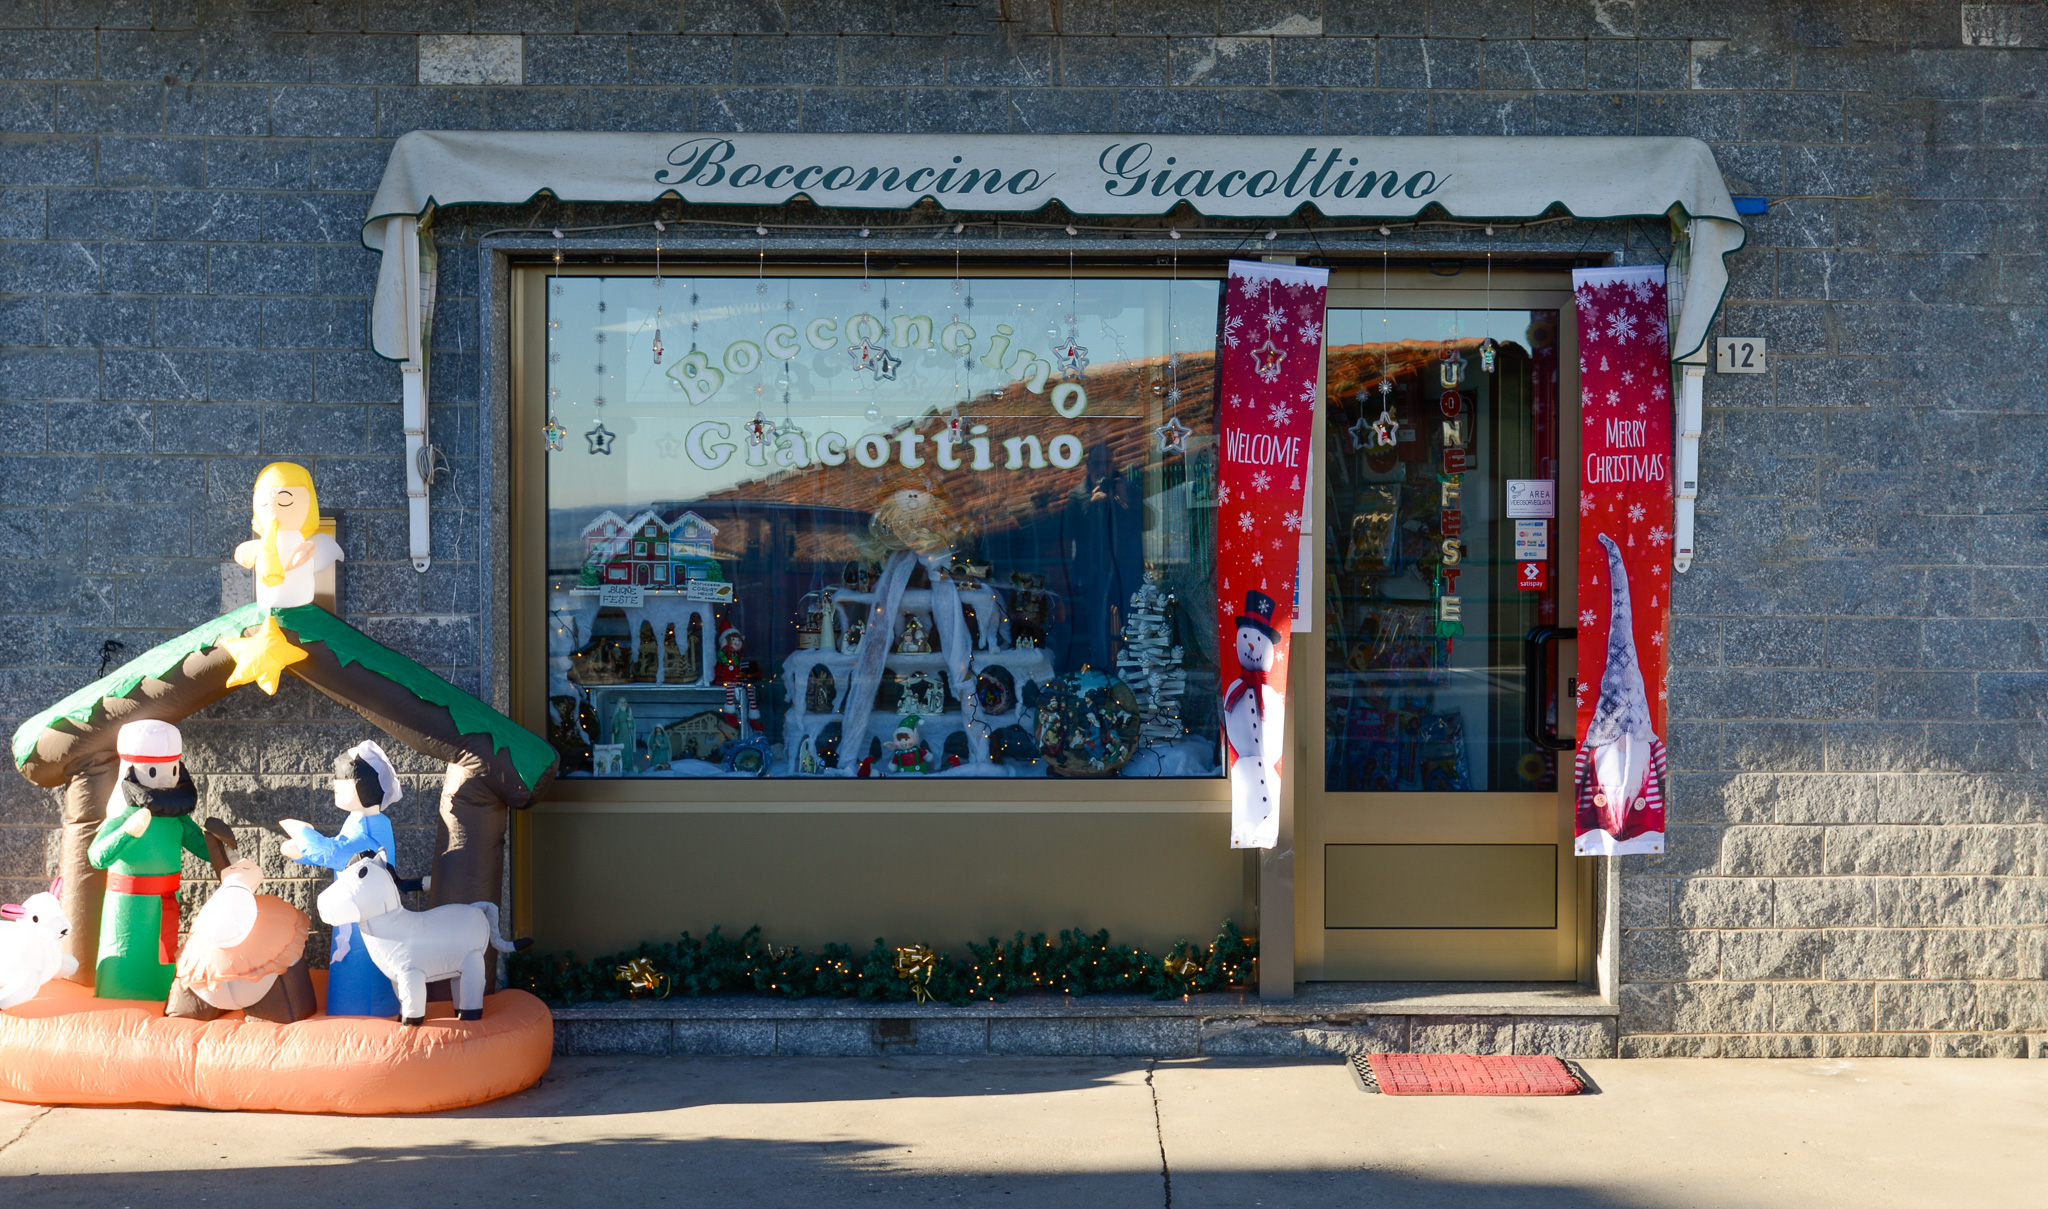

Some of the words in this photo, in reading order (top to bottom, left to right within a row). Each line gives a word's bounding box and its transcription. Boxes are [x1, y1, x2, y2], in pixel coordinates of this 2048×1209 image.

[654, 137, 1056, 195] Bocconcino
[1099, 142, 1452, 199] Giacottino
[665, 313, 1088, 418] Bocconcino
[1728, 342, 1754, 368] 12
[685, 420, 1083, 471] Giacottino
[1226, 427, 1301, 468] WELCOME
[1605, 417, 1647, 448] MERRY
[1587, 453, 1664, 484] CHRISTMAS
[1529, 490, 1551, 498] AREA
[1441, 482, 1462, 621] FESTE
[603, 595, 639, 604] FESTE
[608, 585, 637, 595] BUONE
